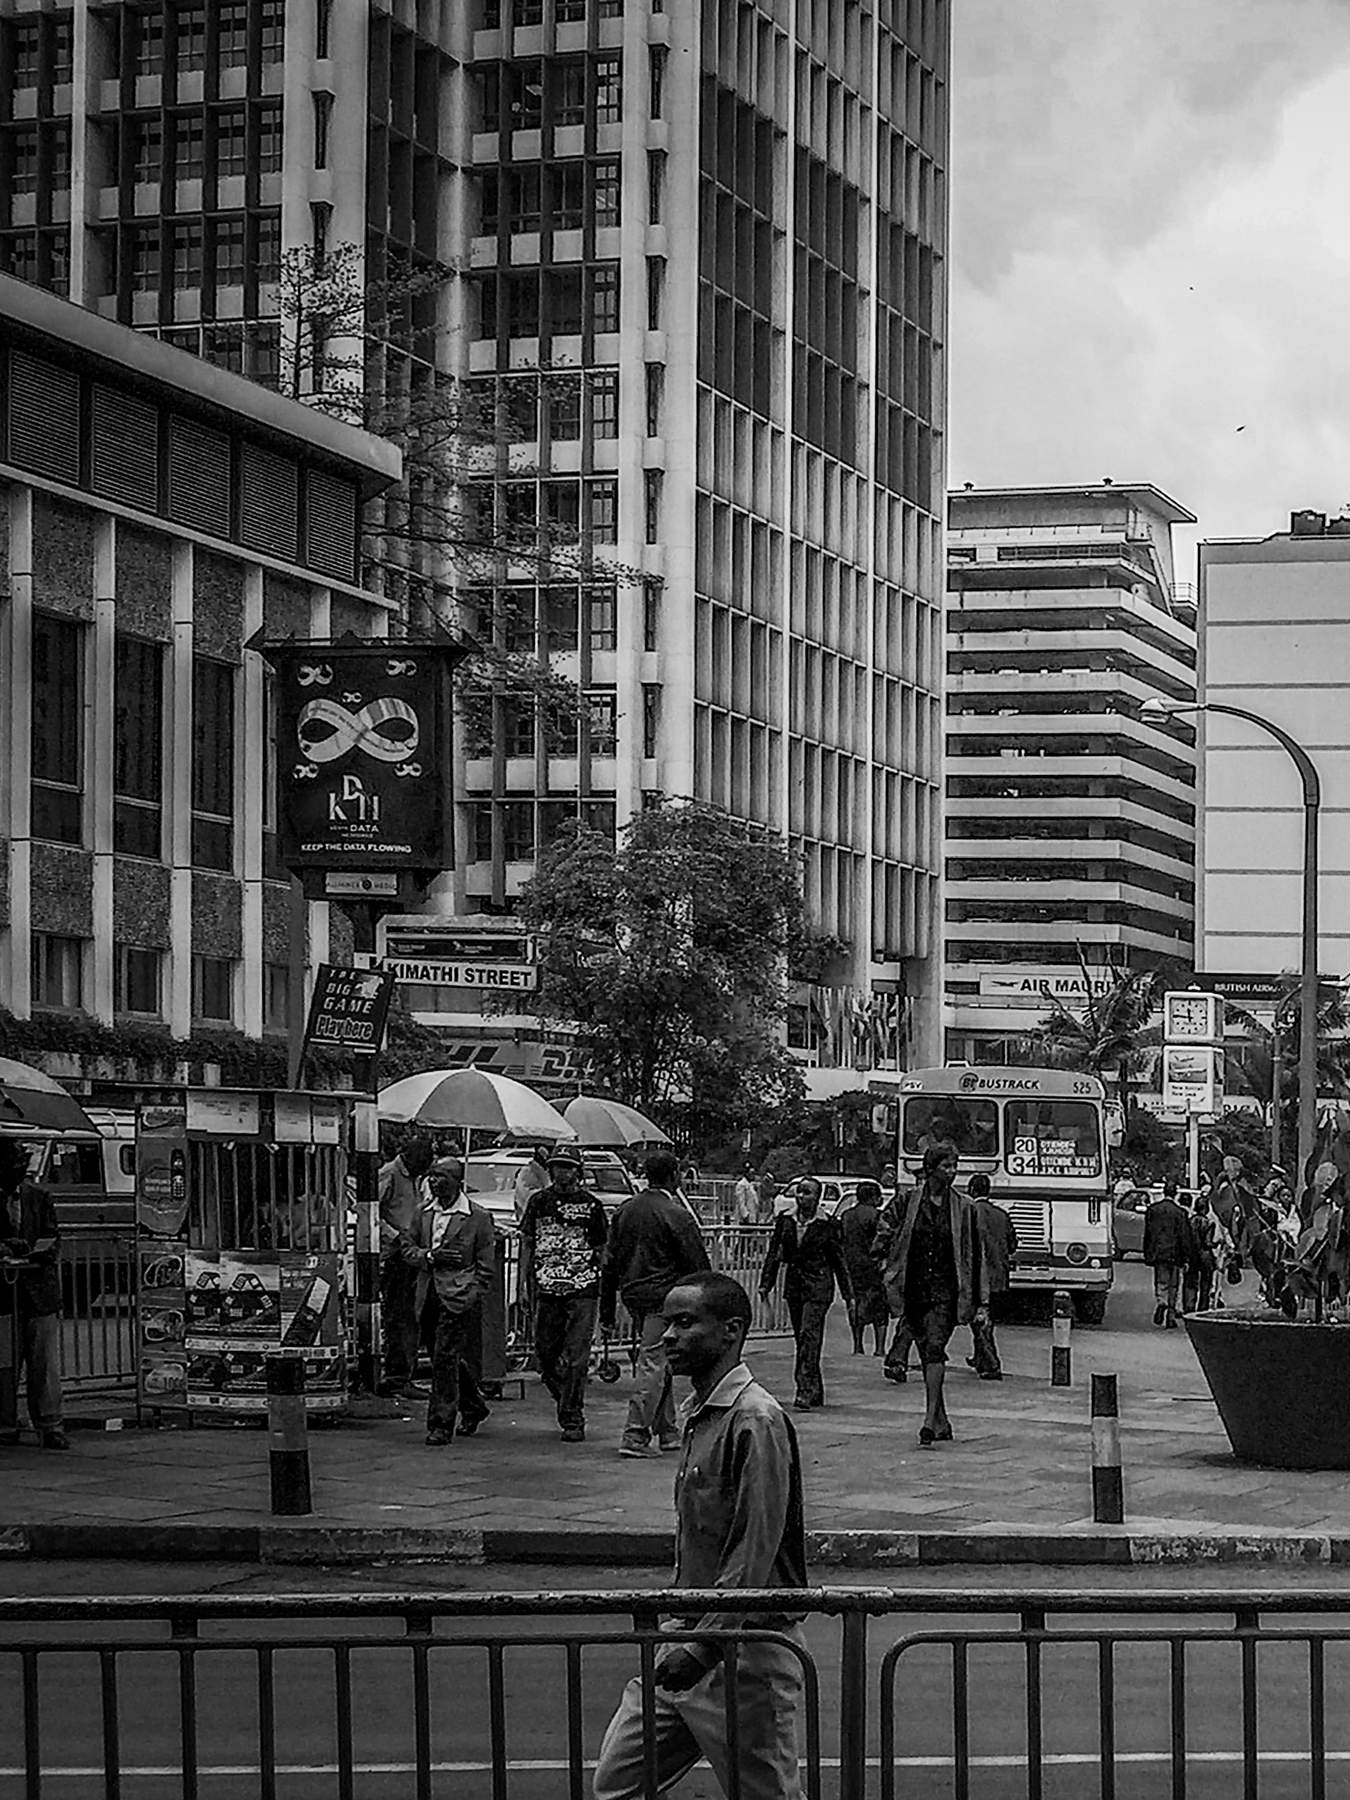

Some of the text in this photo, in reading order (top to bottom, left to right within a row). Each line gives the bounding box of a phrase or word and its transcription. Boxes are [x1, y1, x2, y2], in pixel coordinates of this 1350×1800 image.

[350, 824, 379, 833] DATA
[301, 843, 412, 854] KEEP THE DATA FLOWING
[387, 963, 532, 987] KIMATHI STREET
[326, 982, 352, 995] BIG
[1020, 979, 1050, 992] AIR
[1214, 983, 1251, 992] BRITISH
[324, 997, 374, 1014] GAME
[316, 1014, 374, 1040] Play here
[978, 1078, 1040, 1091] BUSTRACK
[1073, 1081, 1092, 1094] 525
[1016, 1139, 1035, 1153] 20
[1013, 1156, 1037, 1174] 34
